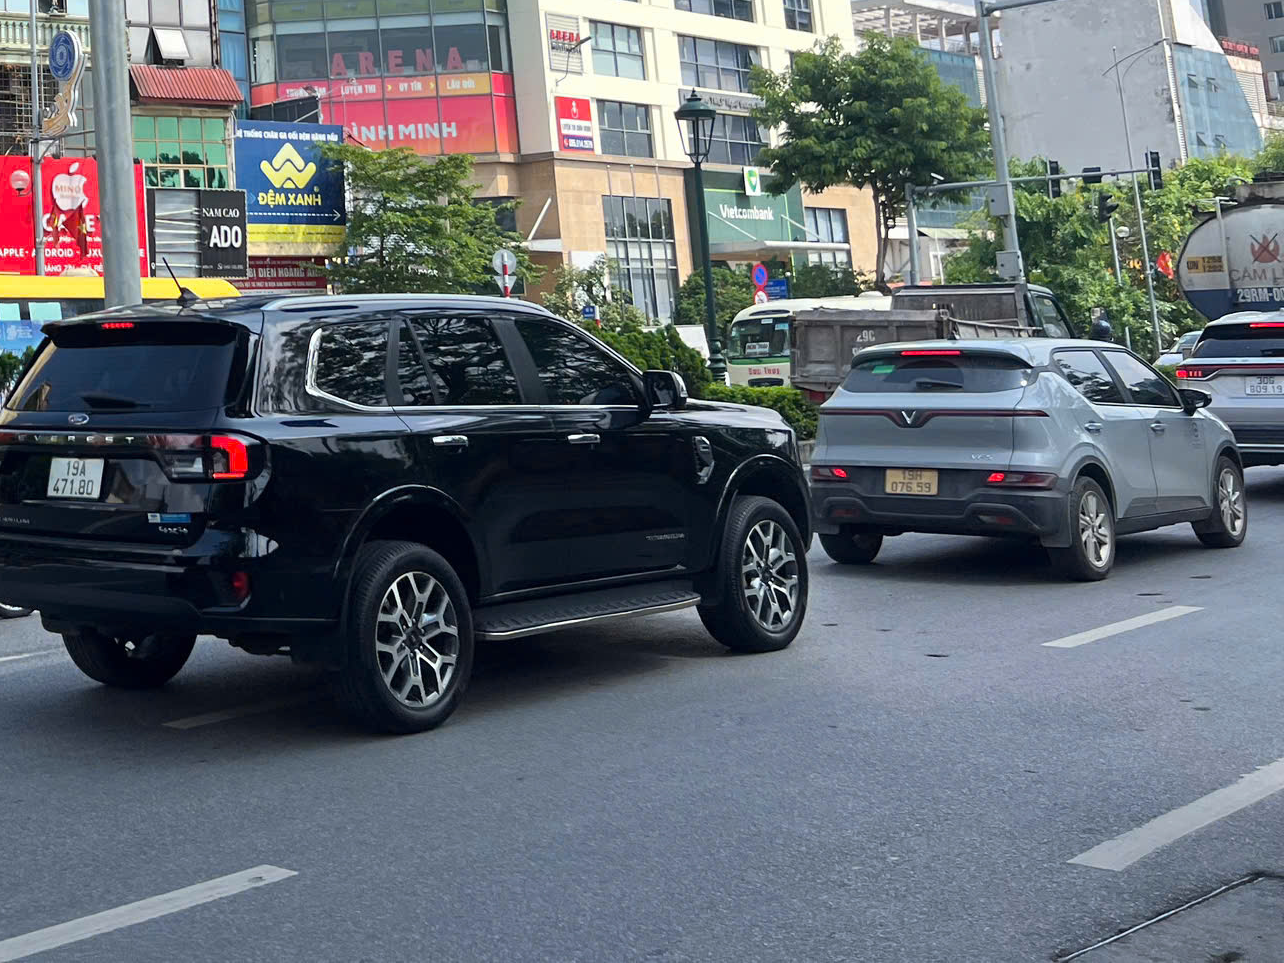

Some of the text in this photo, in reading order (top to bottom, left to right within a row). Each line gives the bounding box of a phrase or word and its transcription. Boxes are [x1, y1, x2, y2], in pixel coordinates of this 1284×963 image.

[330, 45, 465, 78] ARENA
[399, 122, 458, 140] MINH
[257, 189, 322, 209] ĐỆM XANH
[202, 208, 240, 218] NAM CAO
[719, 204, 775, 221] Vietcombank
[209, 225, 242, 249] ADO
[32, 248, 74, 258] ADROID
[18, 435, 135, 444] EVEREST
[66, 460, 87, 477] 19A
[52, 479, 95, 496] 471.80
